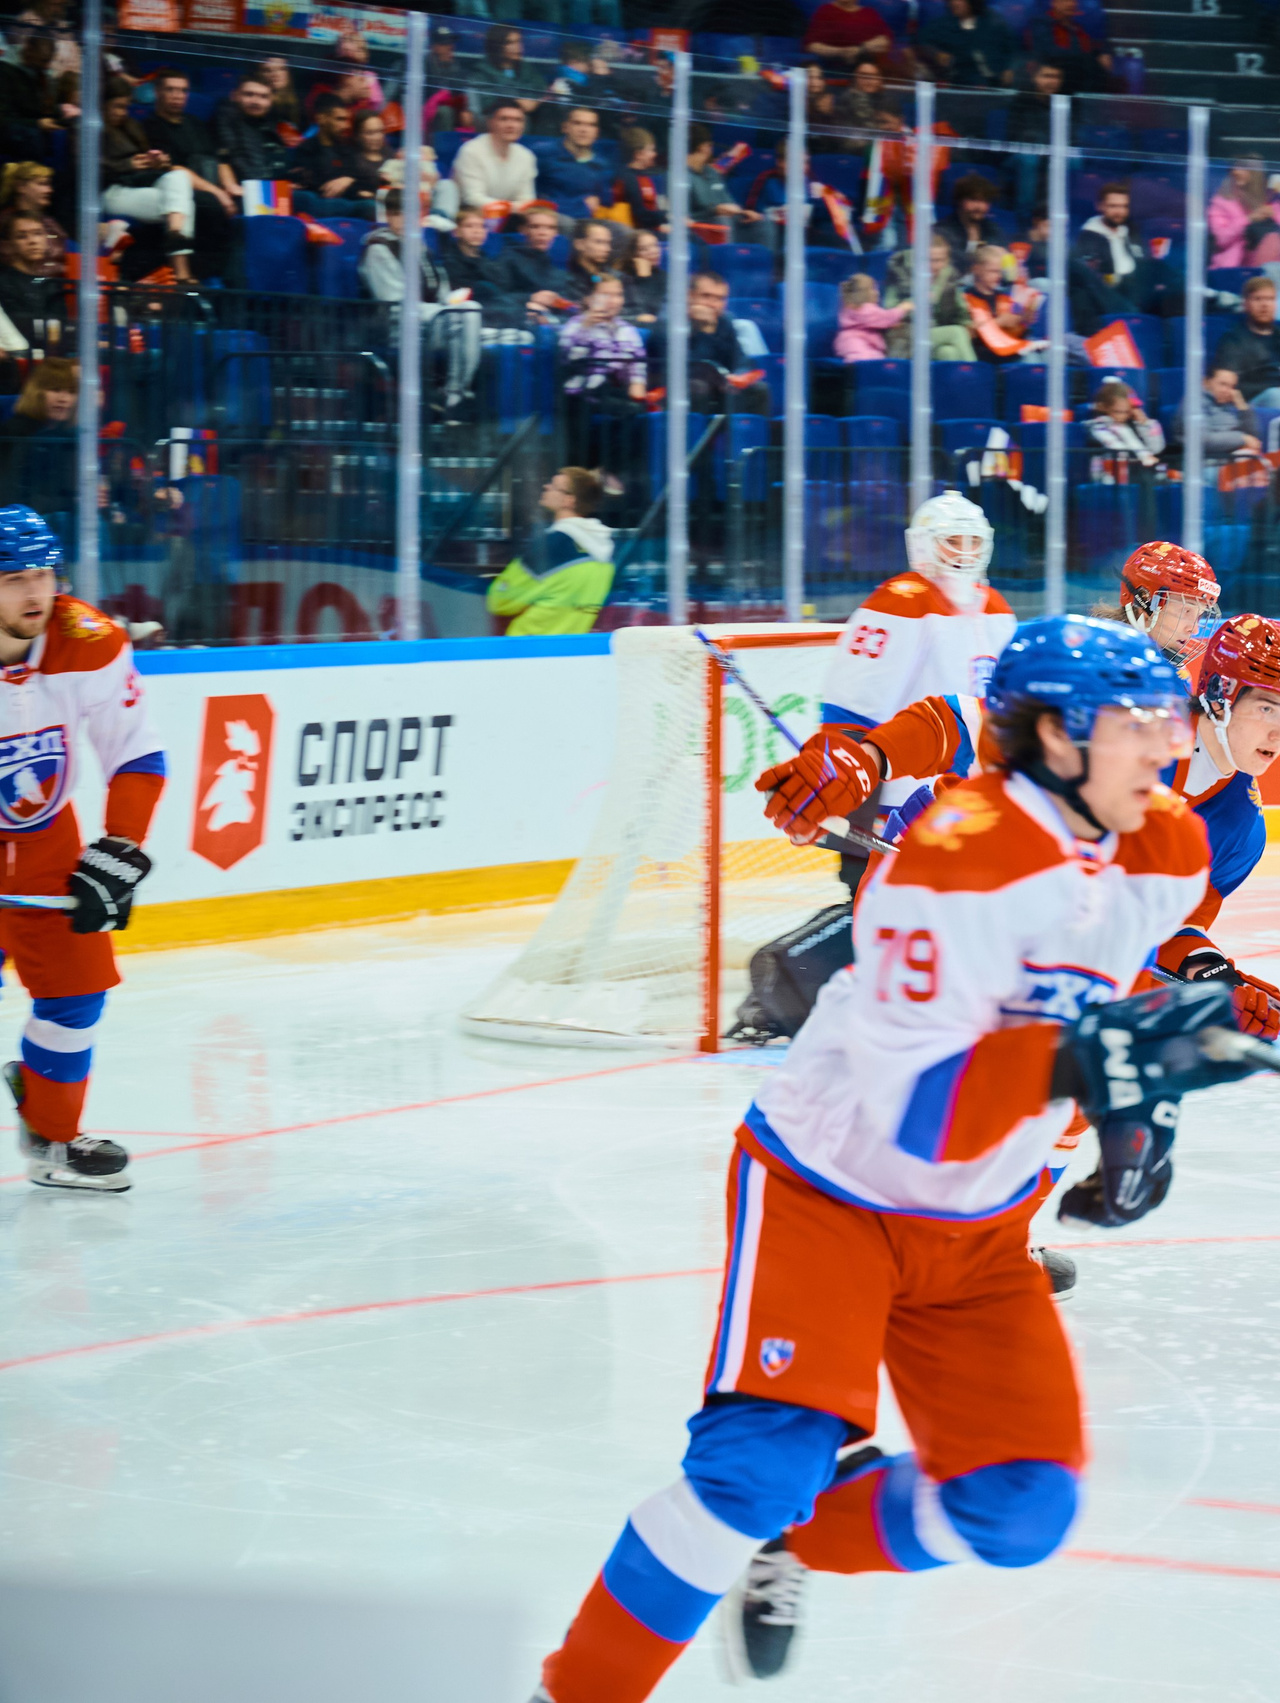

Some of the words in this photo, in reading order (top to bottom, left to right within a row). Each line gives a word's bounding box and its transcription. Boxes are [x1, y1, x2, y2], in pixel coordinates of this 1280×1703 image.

[849, 625, 890, 659] 83
[297, 714, 456, 786] СПОРТ
[832, 746, 871, 803] CC
[289, 790, 445, 841] ЭКСПРЕСС
[874, 927, 940, 1003] 79
[1202, 963, 1228, 978] CCM
